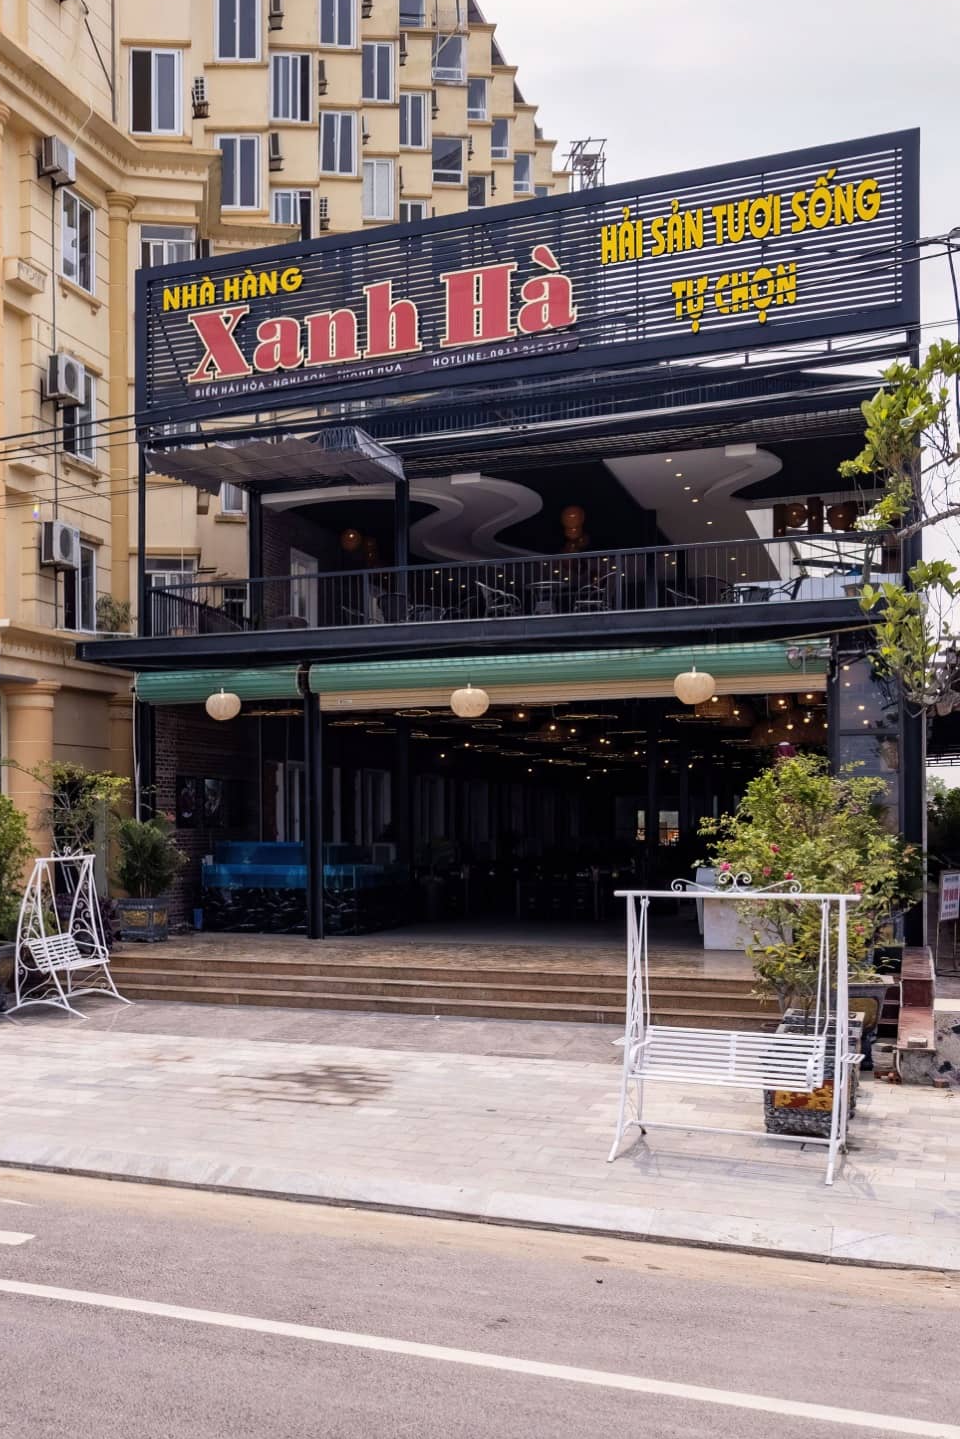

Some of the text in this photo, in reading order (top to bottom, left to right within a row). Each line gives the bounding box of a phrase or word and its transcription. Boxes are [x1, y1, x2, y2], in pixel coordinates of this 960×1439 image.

[601, 168, 882, 264] HẢI SẢN TƯƠI SỐNG
[162, 267, 303, 311] NHÀ HÀNG
[187, 244, 577, 383] Xanh Hà
[672, 263, 797, 334] TỰ CHỌN
